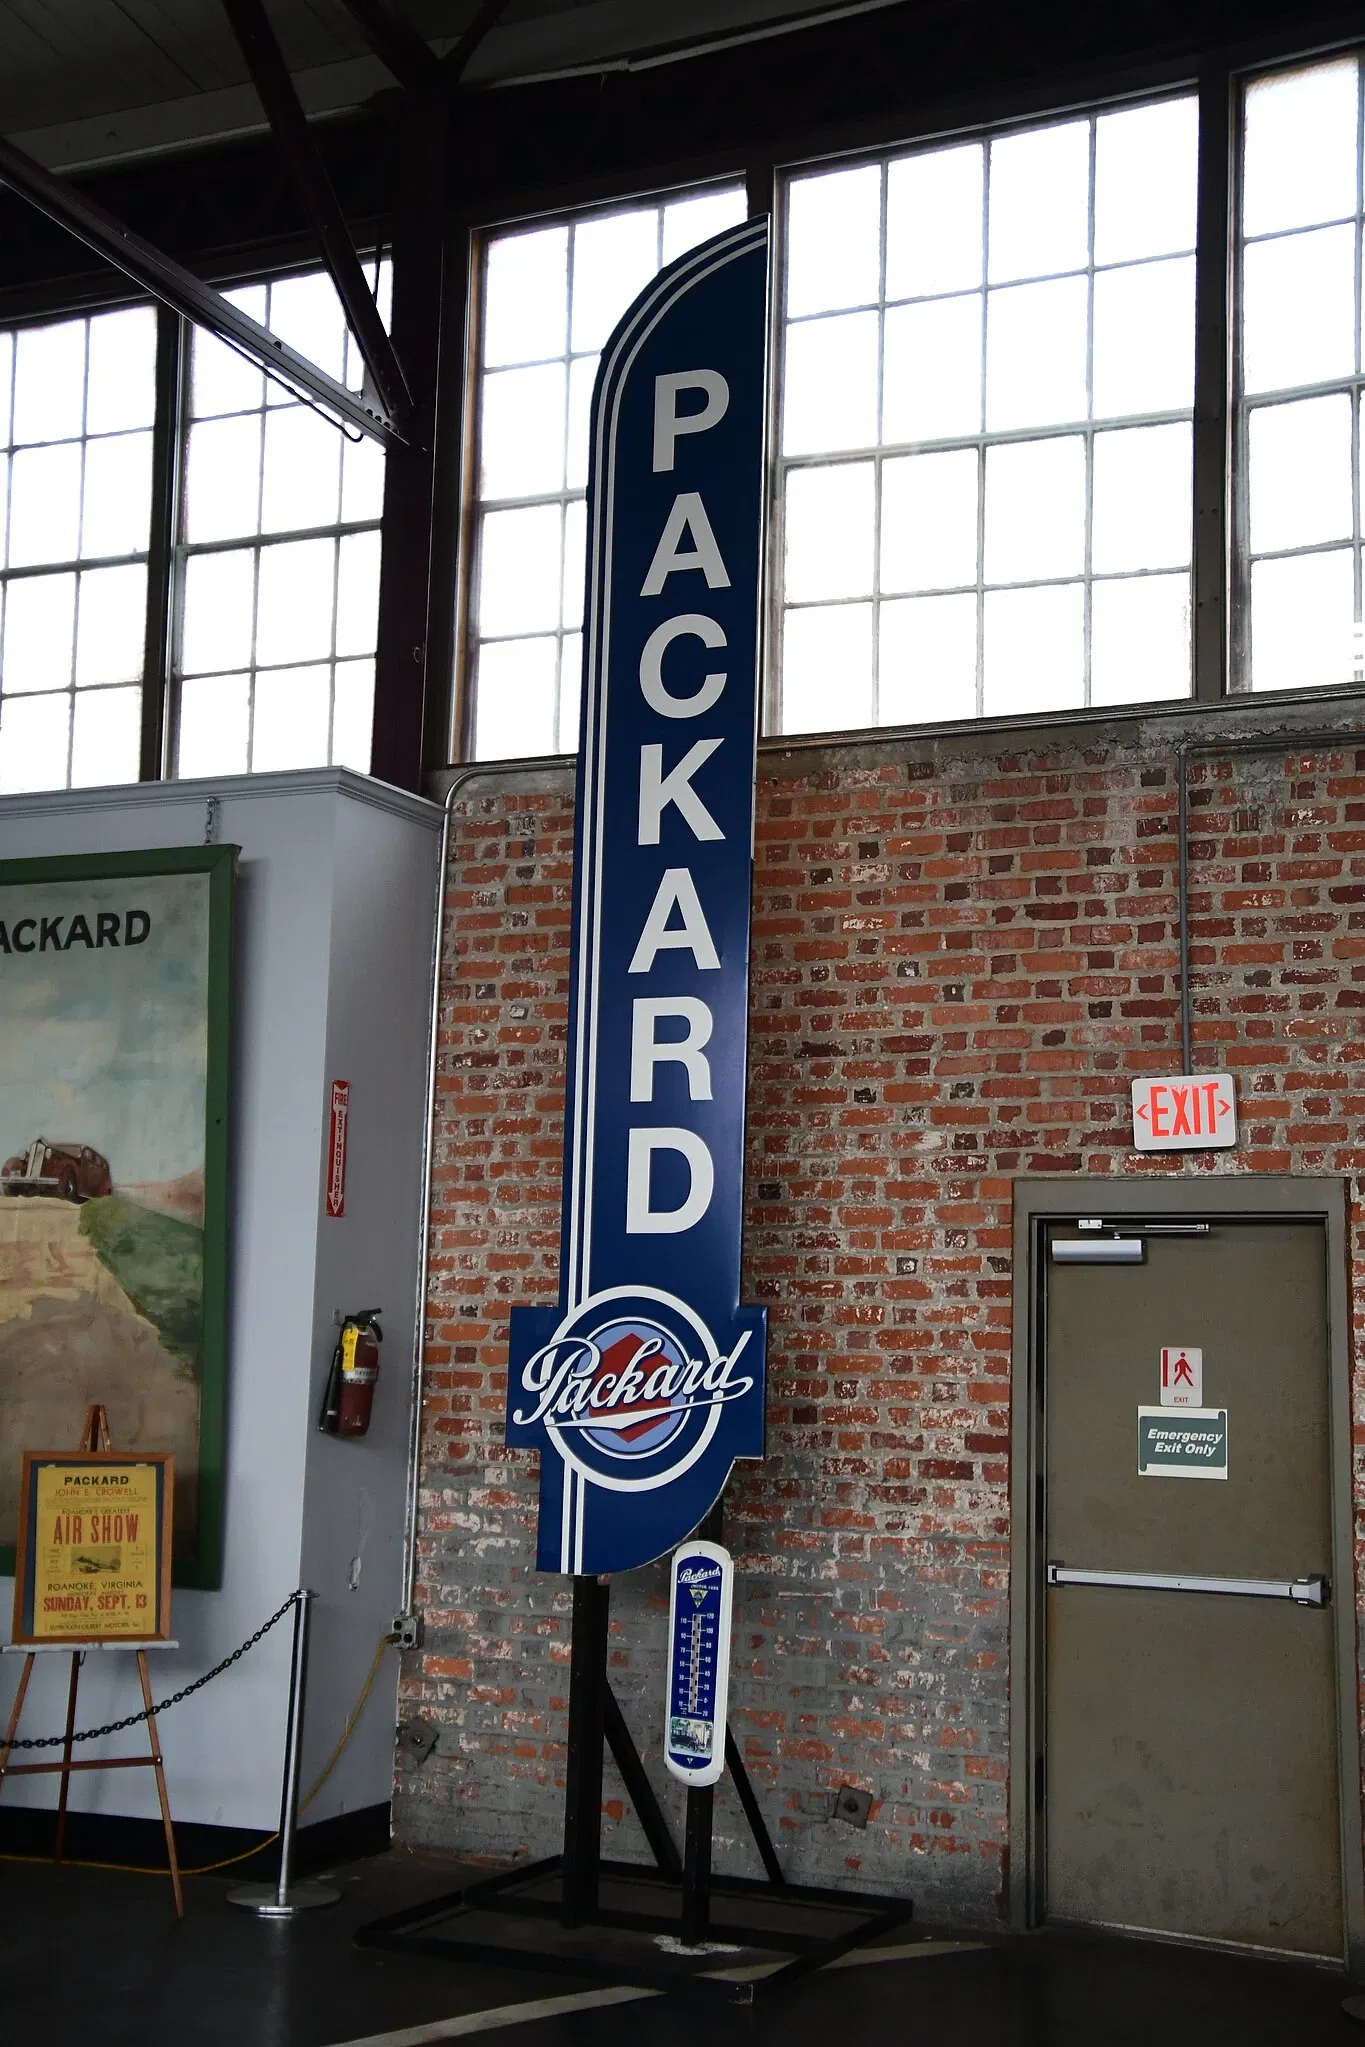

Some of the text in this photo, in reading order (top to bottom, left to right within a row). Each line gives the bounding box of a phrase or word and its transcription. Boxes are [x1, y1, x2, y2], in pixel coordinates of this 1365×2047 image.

[626, 368, 732, 1235] PACKARD
[333, 1091, 348, 1106] FIRE
[1149, 1082, 1219, 1137] EXIT
[332, 1110, 344, 1207] EXTINGUISHER
[512, 1330, 755, 1431] Packard
[1147, 1428, 1224, 1444] Emergency
[1154, 1441, 1216, 1457] Exit Only
[64, 1475, 129, 1486] PACKARD
[55, 1488, 80, 1497] JOHN
[96, 1487, 138, 1496] CROWELL
[53, 1514, 139, 1545] AIR SHOW
[677, 1566, 721, 1584] Packard
[47, 1580, 143, 1591] ROANOKE, VIRGINIA
[43, 1593, 147, 1612] SUNDAY, SEPT. 13
